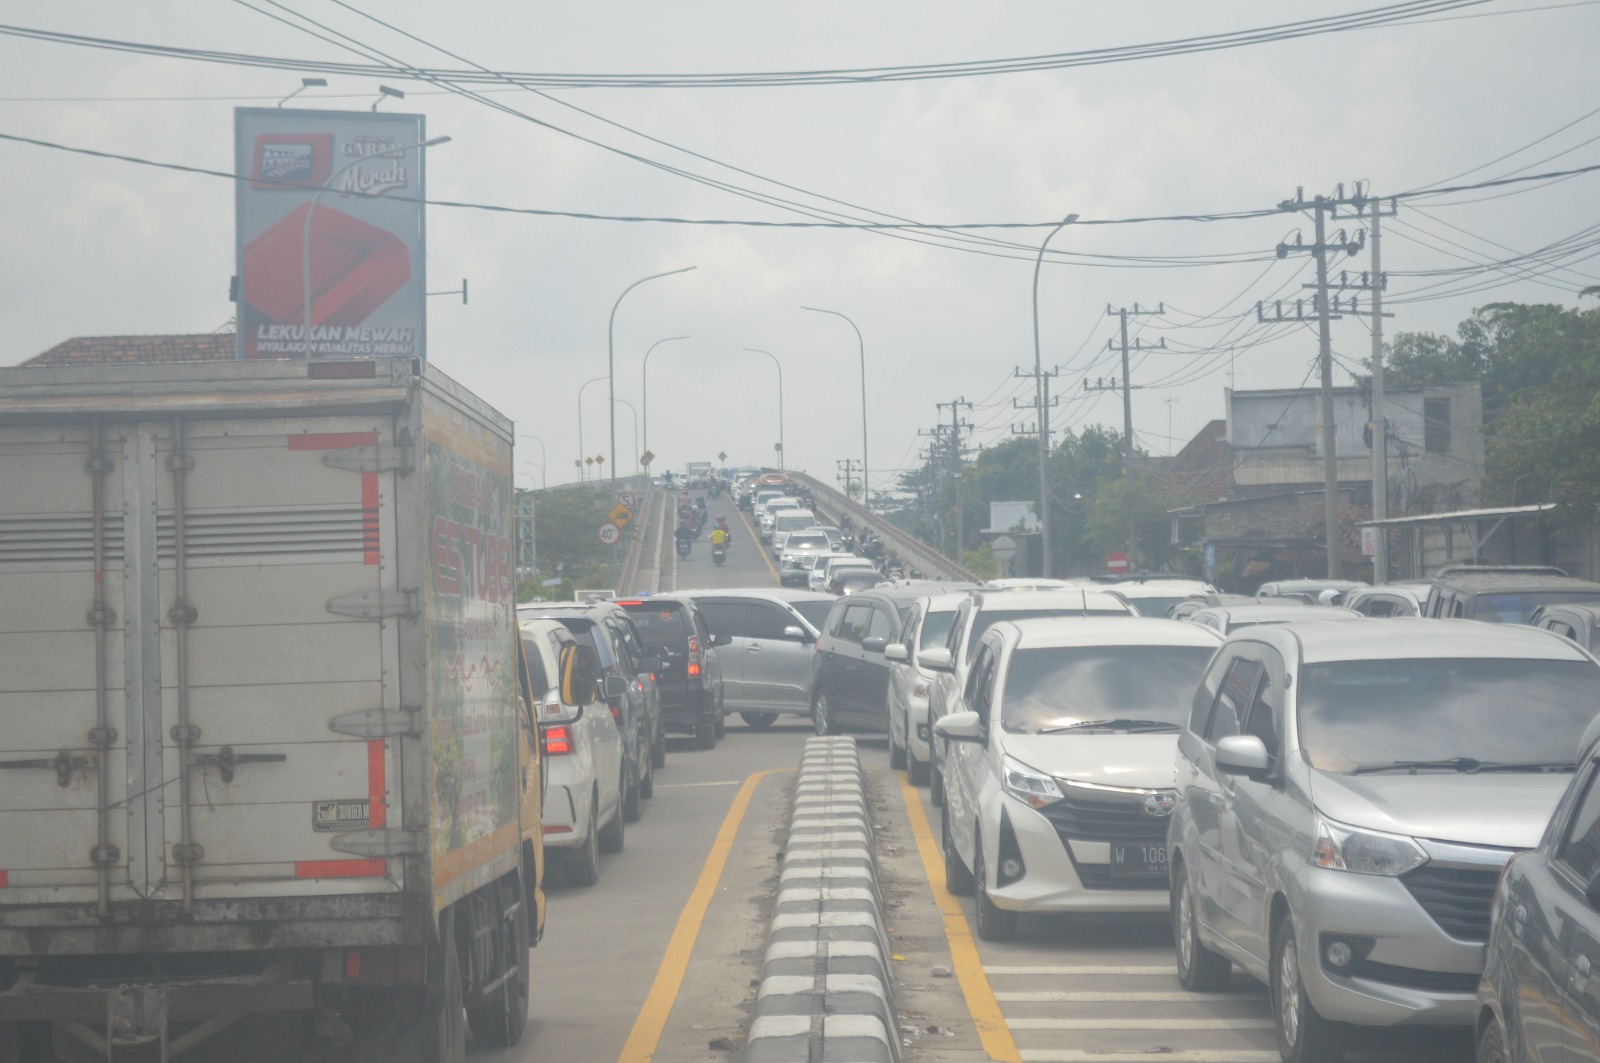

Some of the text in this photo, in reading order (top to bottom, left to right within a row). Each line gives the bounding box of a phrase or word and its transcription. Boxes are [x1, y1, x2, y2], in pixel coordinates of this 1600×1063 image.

[340, 160, 407, 197] Merah
[345, 326, 413, 342] MEWAH
[318, 343, 371, 353] KUALITAS
[373, 344, 413, 354] MERAH
[601, 528, 613, 540] 40
[433, 515, 510, 605] ES TUBE
[338, 804, 362, 820] SUMBER
[1115, 847, 1168, 864] W 106
